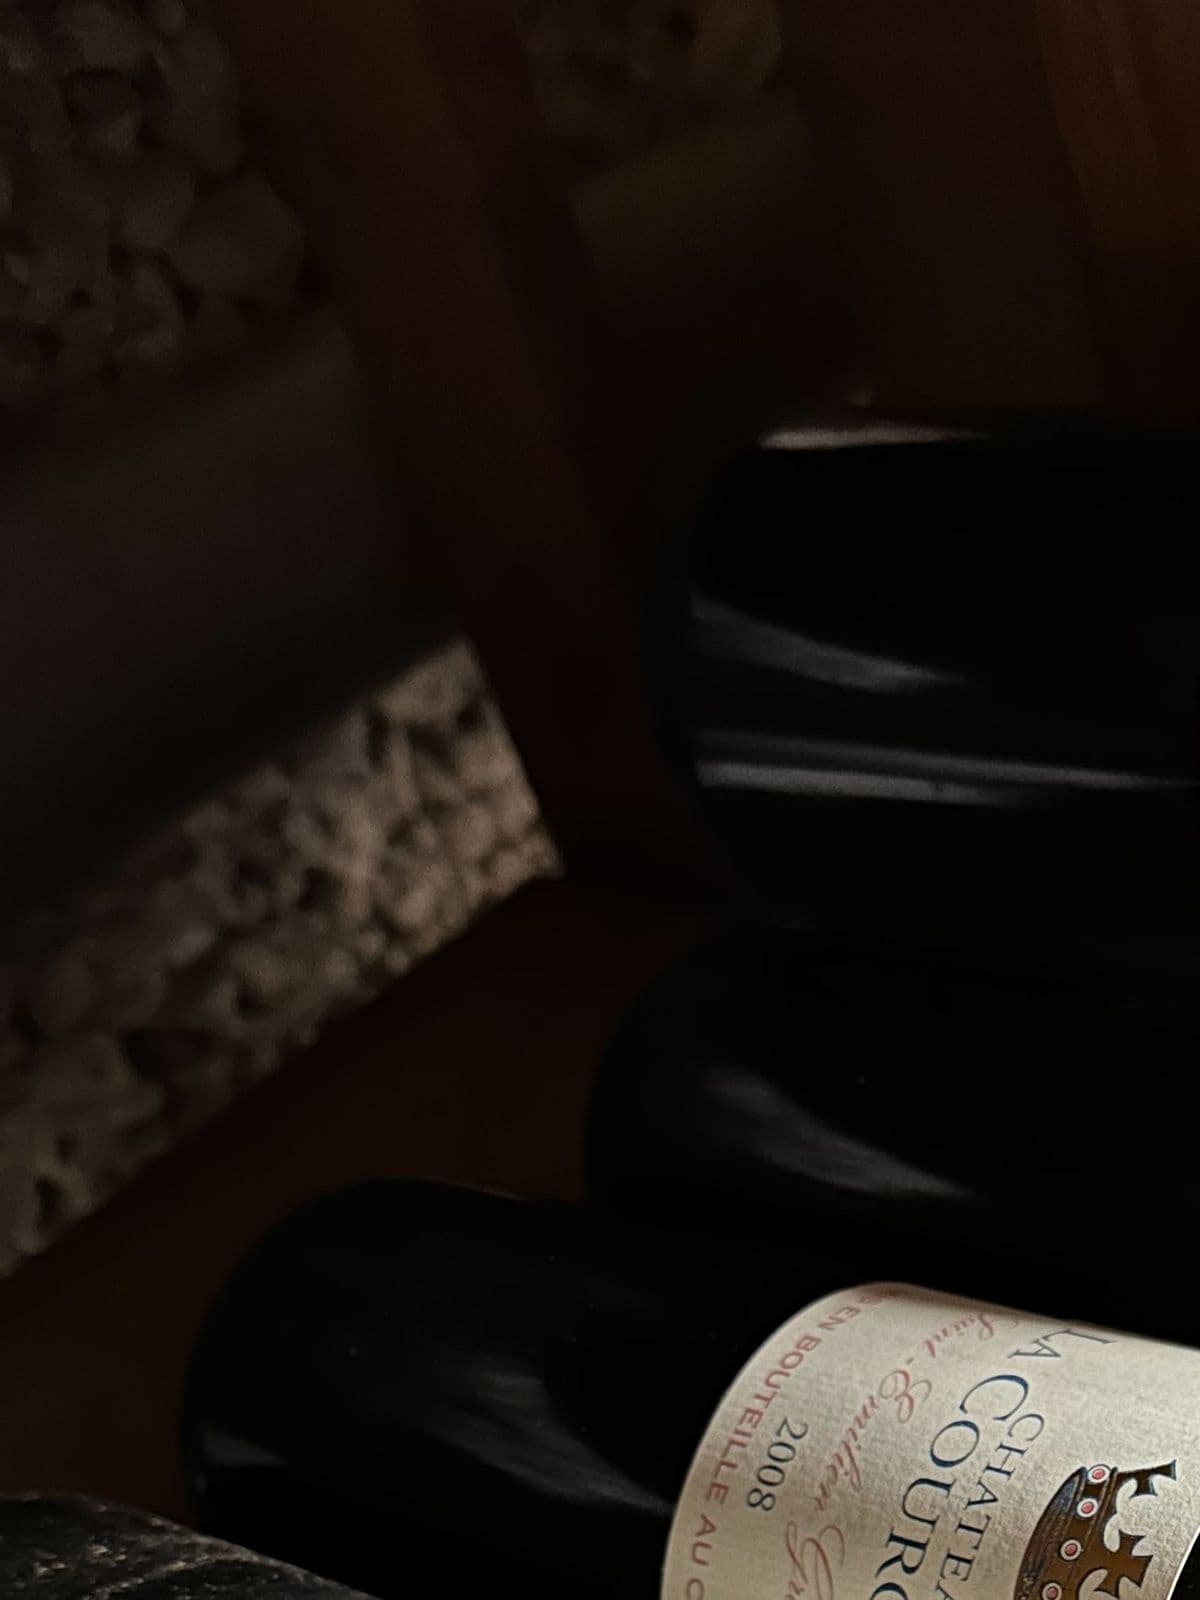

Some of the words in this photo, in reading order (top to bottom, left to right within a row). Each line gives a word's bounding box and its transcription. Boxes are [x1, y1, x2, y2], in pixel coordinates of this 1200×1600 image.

[817, 1302, 864, 1332] EN
[1007, 1328, 1119, 1361] LA
[705, 1335, 823, 1506] BOUTEILLE
[747, 1415, 809, 1513] 2008
[690, 1517, 718, 1569] AU
